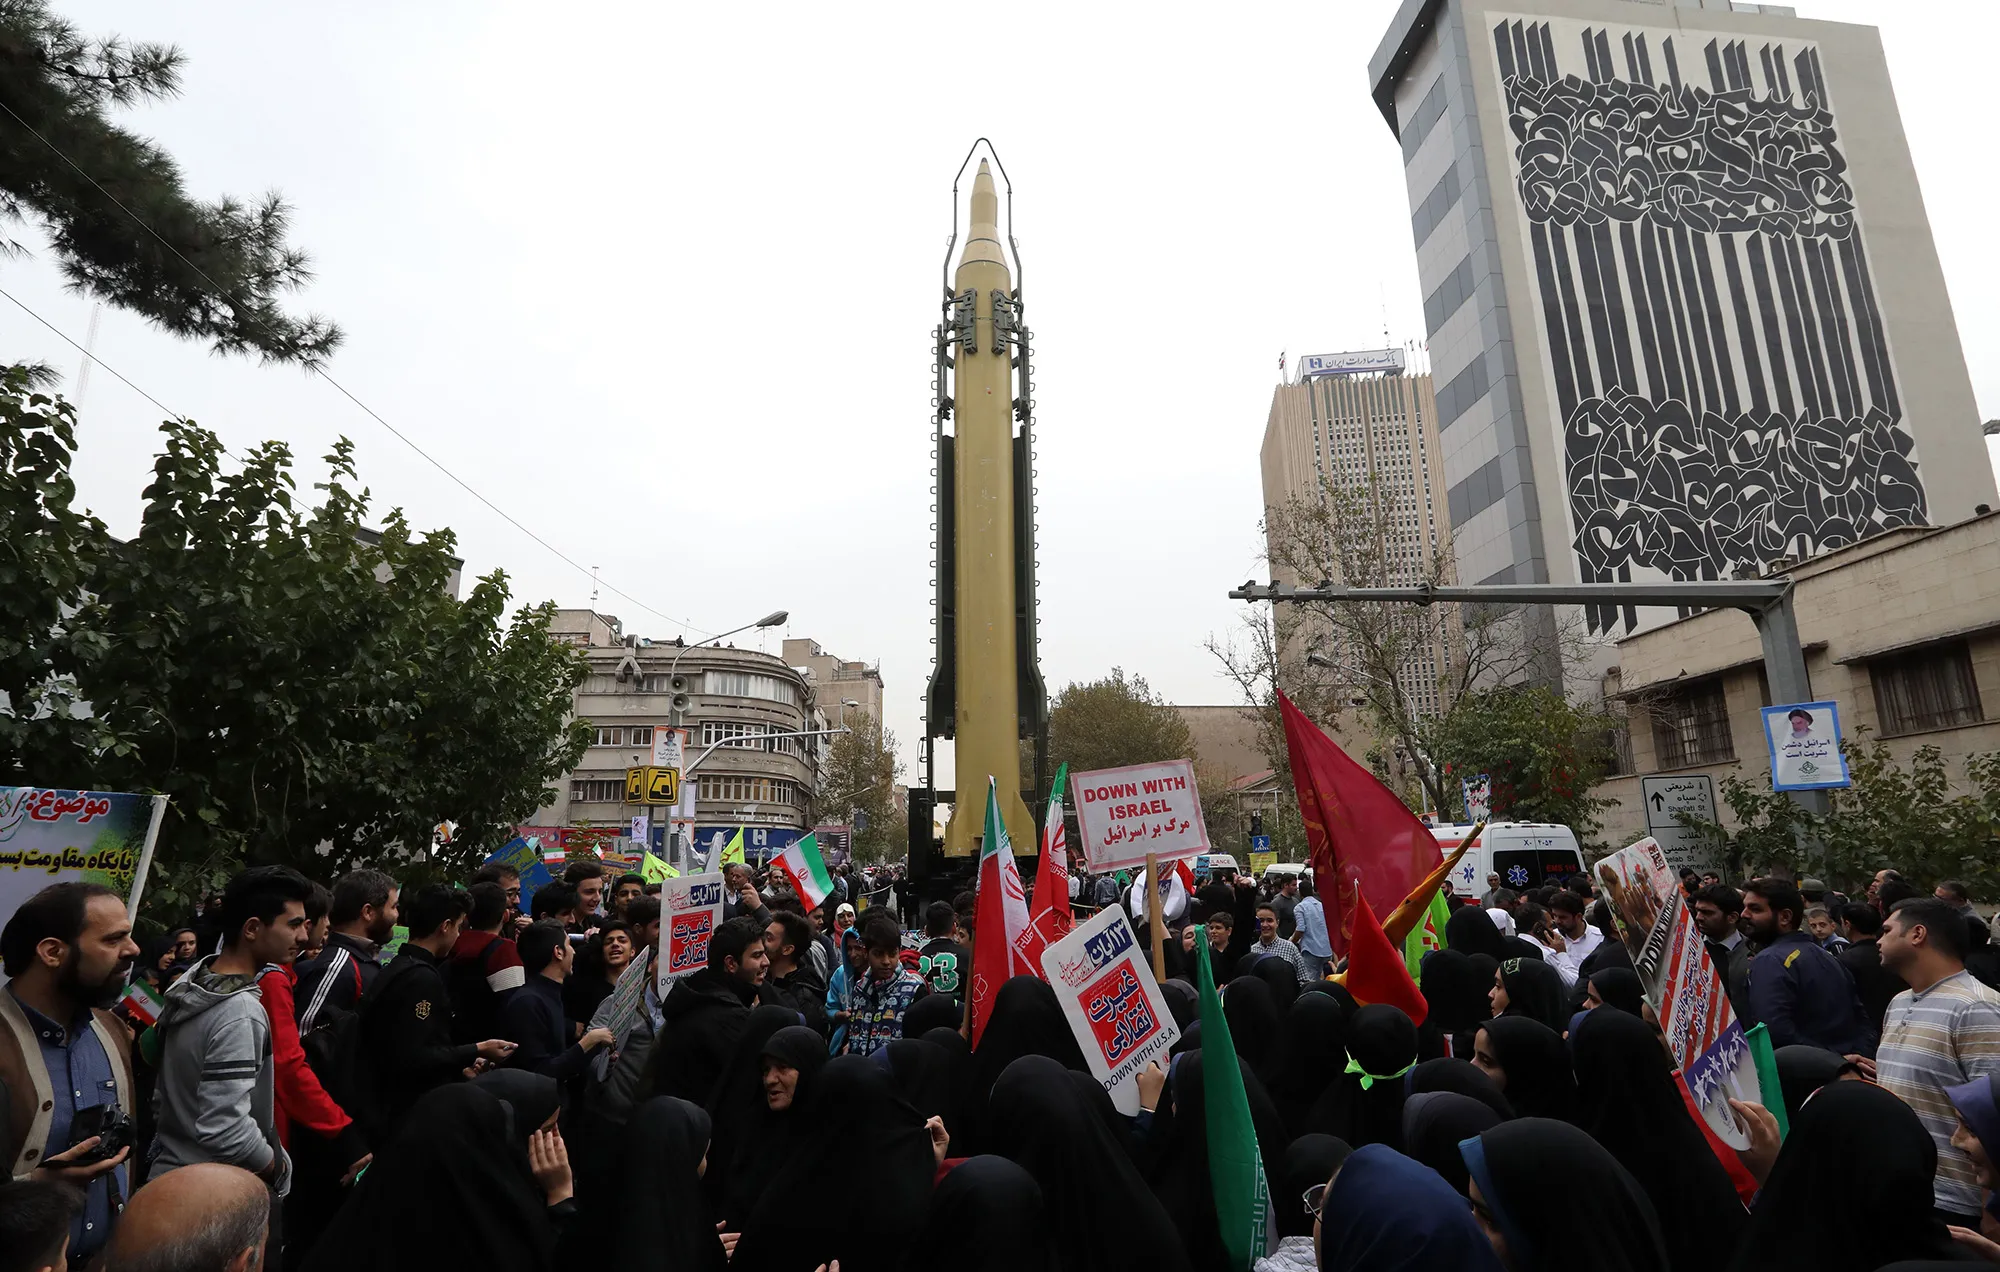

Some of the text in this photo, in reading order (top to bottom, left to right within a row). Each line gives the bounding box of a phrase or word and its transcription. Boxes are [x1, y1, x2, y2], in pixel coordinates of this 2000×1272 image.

[1326, 350, 1396, 368] بانک صادرات ایران
[1781, 739, 1831, 750] اسرائیل دشمن
[1083, 776, 1186, 803] DOWN WITH
[1664, 781, 1695, 792] شریعتی
[1677, 794, 1696, 803] سپاه
[26, 791, 110, 822] موضوع:
[1108, 799, 1172, 820] ISRAEL
[1103, 817, 1190, 846] مرگ بر اسرائیل
[24, 848, 85, 873] مقاومت
[1664, 844, 1688, 854] خمینی
[89, 850, 133, 877] پایگاه
[1546, 863, 1563, 873] EMS
[690, 884, 709, 904] آبان
[709, 885, 720, 901] ۱۳
[673, 915, 711, 943] غیرت
[1090, 919, 1126, 962] ۱۳ آبان
[1640, 926, 1667, 973] DOWN
[1659, 905, 1672, 927] WITH
[671, 935, 710, 968] انقلابی
[1087, 968, 1139, 1023] غیرت
[1104, 995, 1154, 1061] انقلابی
[1104, 1029, 1176, 1092] DOWN WITH U.S.A
